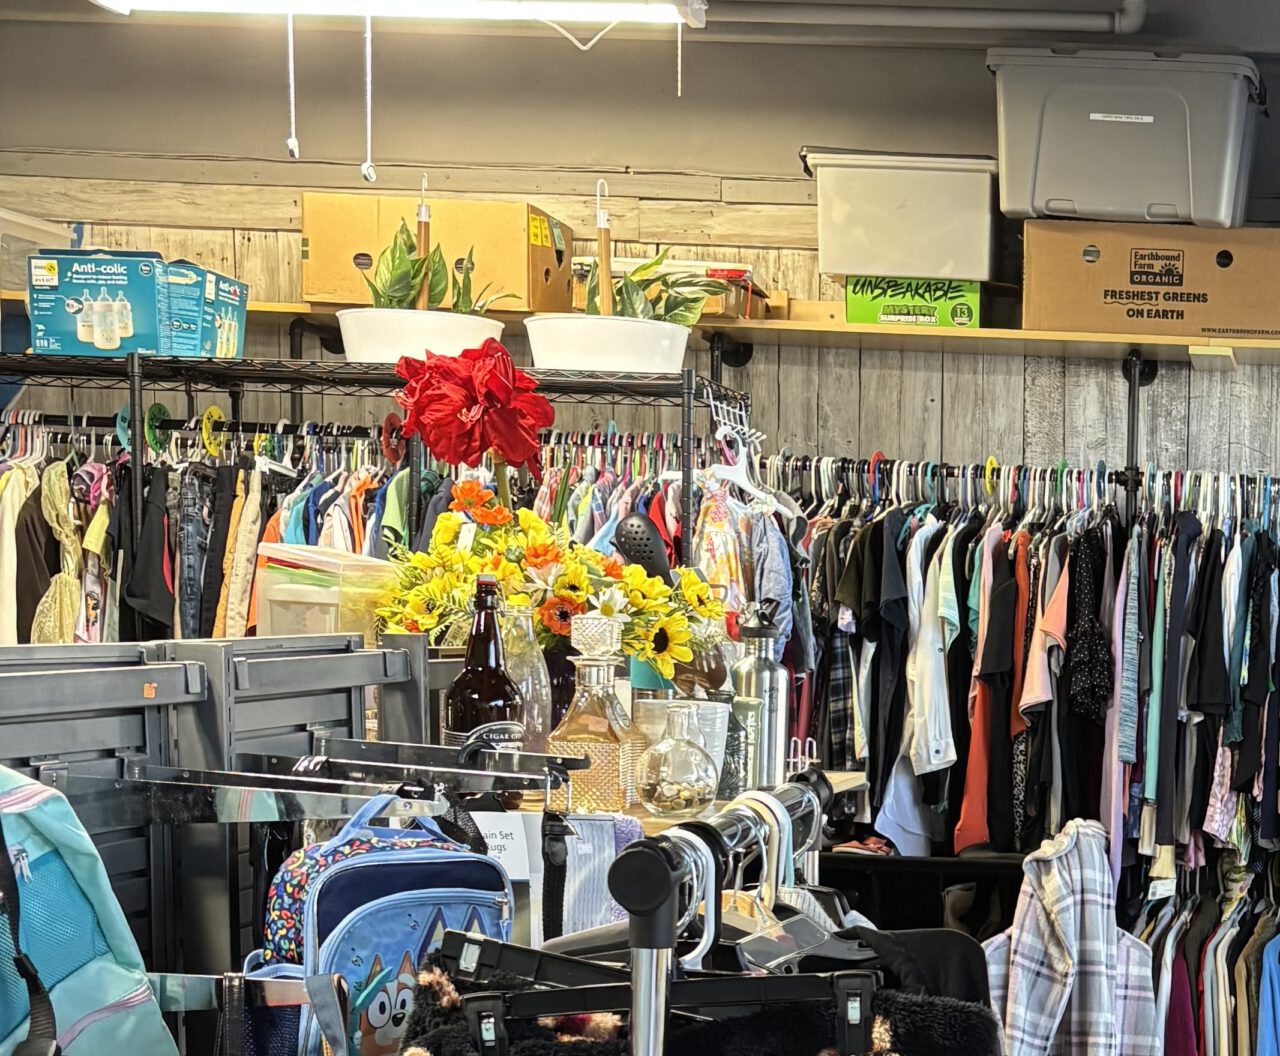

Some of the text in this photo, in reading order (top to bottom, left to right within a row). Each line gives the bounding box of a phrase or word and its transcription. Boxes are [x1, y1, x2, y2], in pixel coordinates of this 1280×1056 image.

[1134, 251, 1181, 262] Earthbound
[72, 262, 128, 274] Anti-colic
[1134, 261, 1155, 270] Farm
[1133, 274, 1181, 284] ORGANIC
[852, 277, 967, 304] UNSPEAKABLE
[1103, 290, 1208, 303] FRESHEST GREENS
[882, 304, 938, 316] MYSTERY
[1126, 308, 1184, 320] ON EARTH
[482, 732, 509, 740] CIGAR
[499, 831, 514, 840] Set
